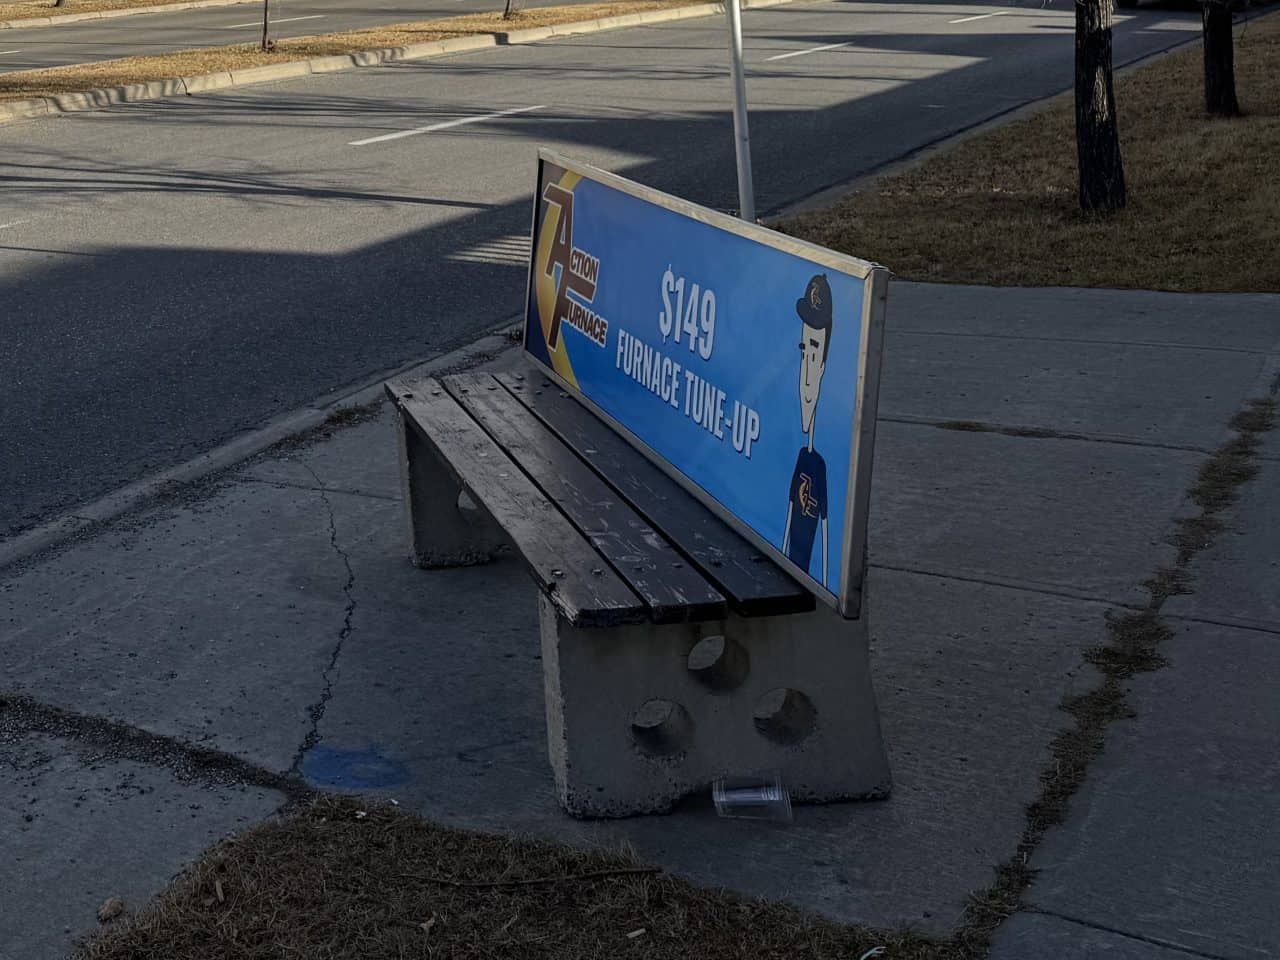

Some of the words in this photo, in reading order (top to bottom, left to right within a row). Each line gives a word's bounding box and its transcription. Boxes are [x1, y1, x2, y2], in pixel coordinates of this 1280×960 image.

[659, 264, 716, 359] $149
[616, 329, 681, 408] FURNACE
[685, 370, 760, 458] TUNE-UP
